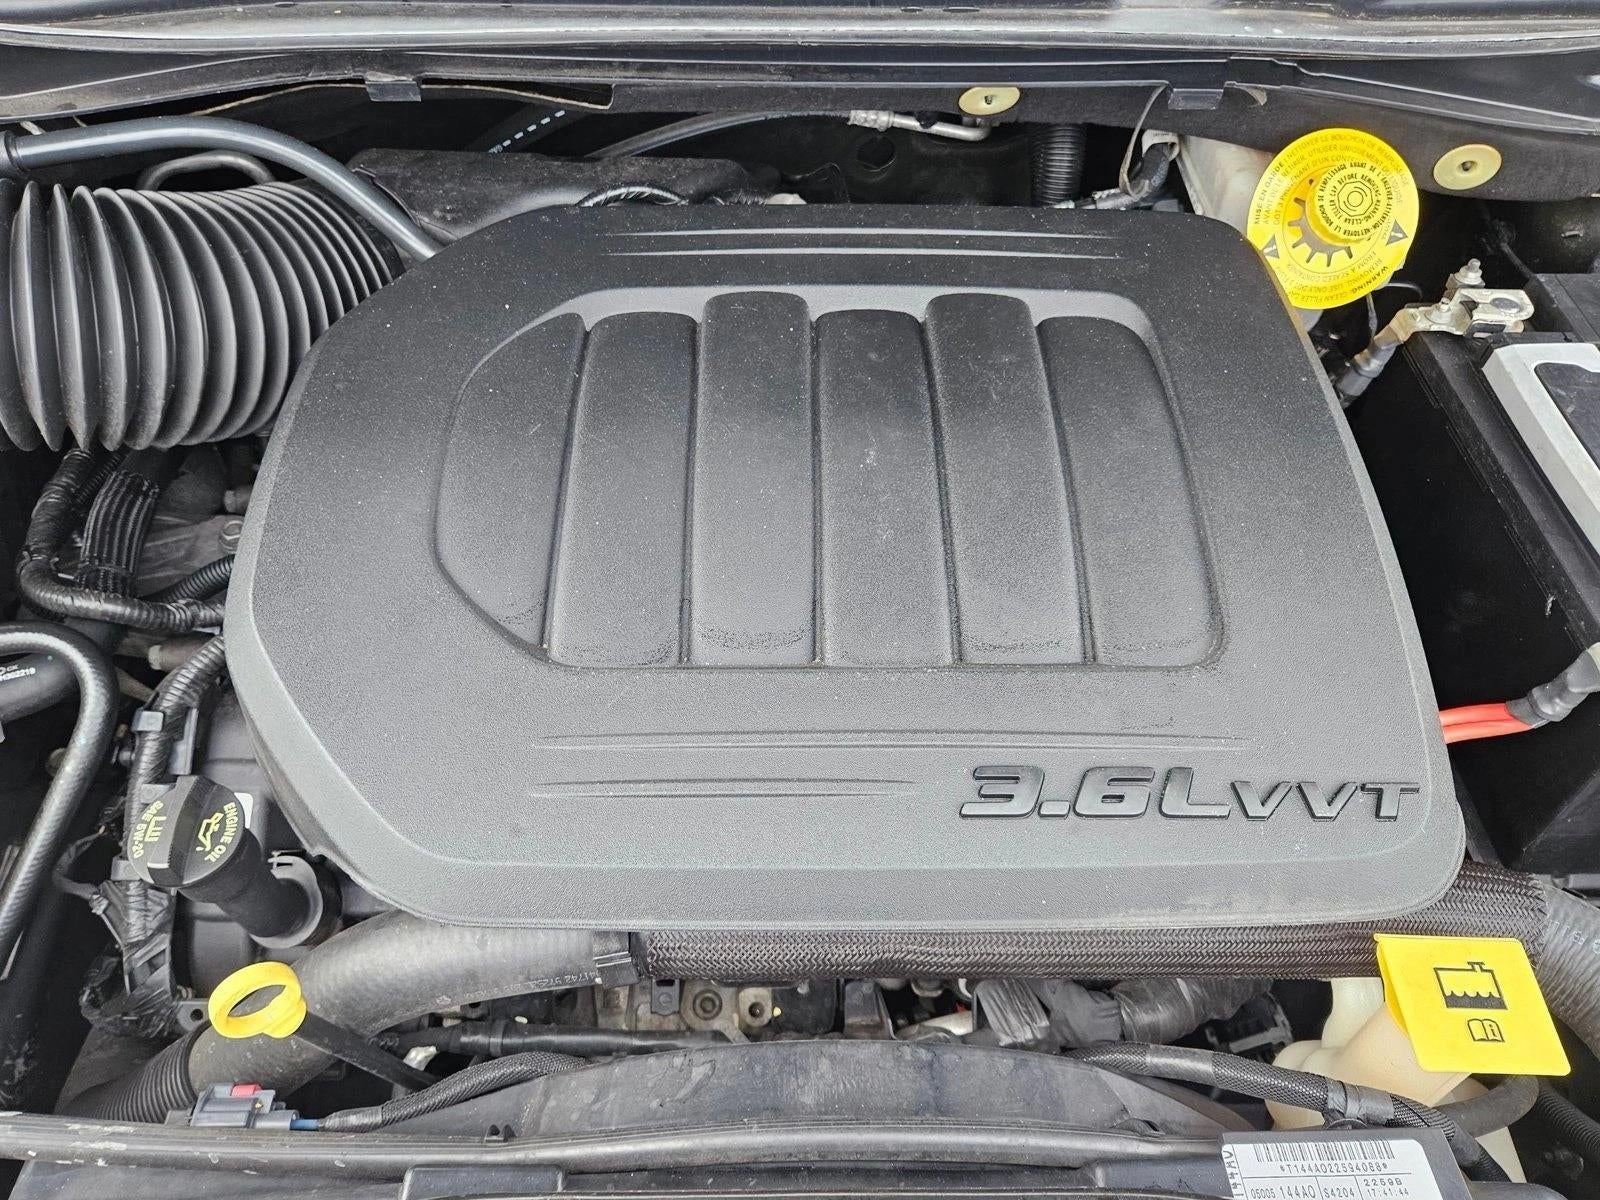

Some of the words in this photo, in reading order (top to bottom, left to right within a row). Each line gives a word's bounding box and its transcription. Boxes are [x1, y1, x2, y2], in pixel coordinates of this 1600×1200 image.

[1253, 202, 1263, 224] MISE
[220, 801, 239, 844] ENGINE
[204, 844, 227, 863] OIL
[1323, 1187, 1356, 1198] S4204
